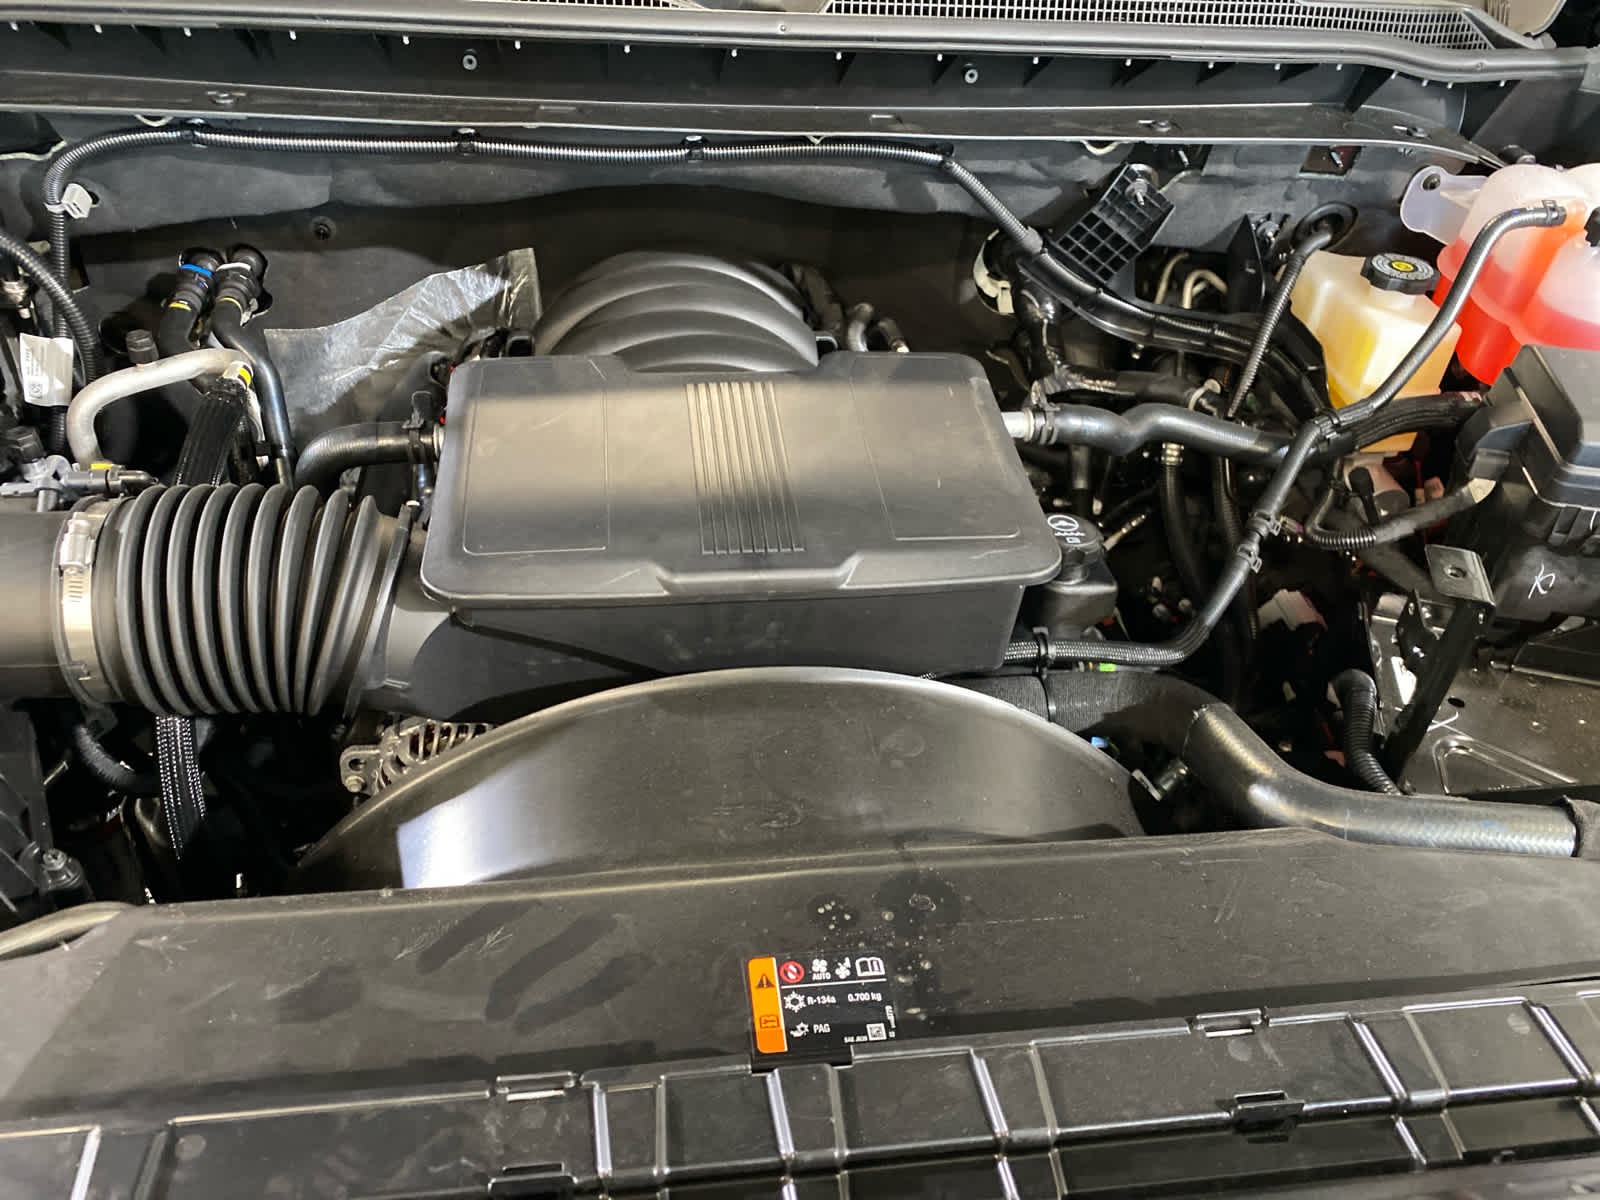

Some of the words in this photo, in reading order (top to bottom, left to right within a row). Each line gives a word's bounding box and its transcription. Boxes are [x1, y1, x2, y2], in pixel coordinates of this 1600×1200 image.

[812, 972, 831, 981] AUTO
[807, 994, 836, 1005] R-134a
[847, 992, 870, 1002] 0.700
[871, 992, 882, 1002] kg
[813, 1023, 831, 1034] PAG
